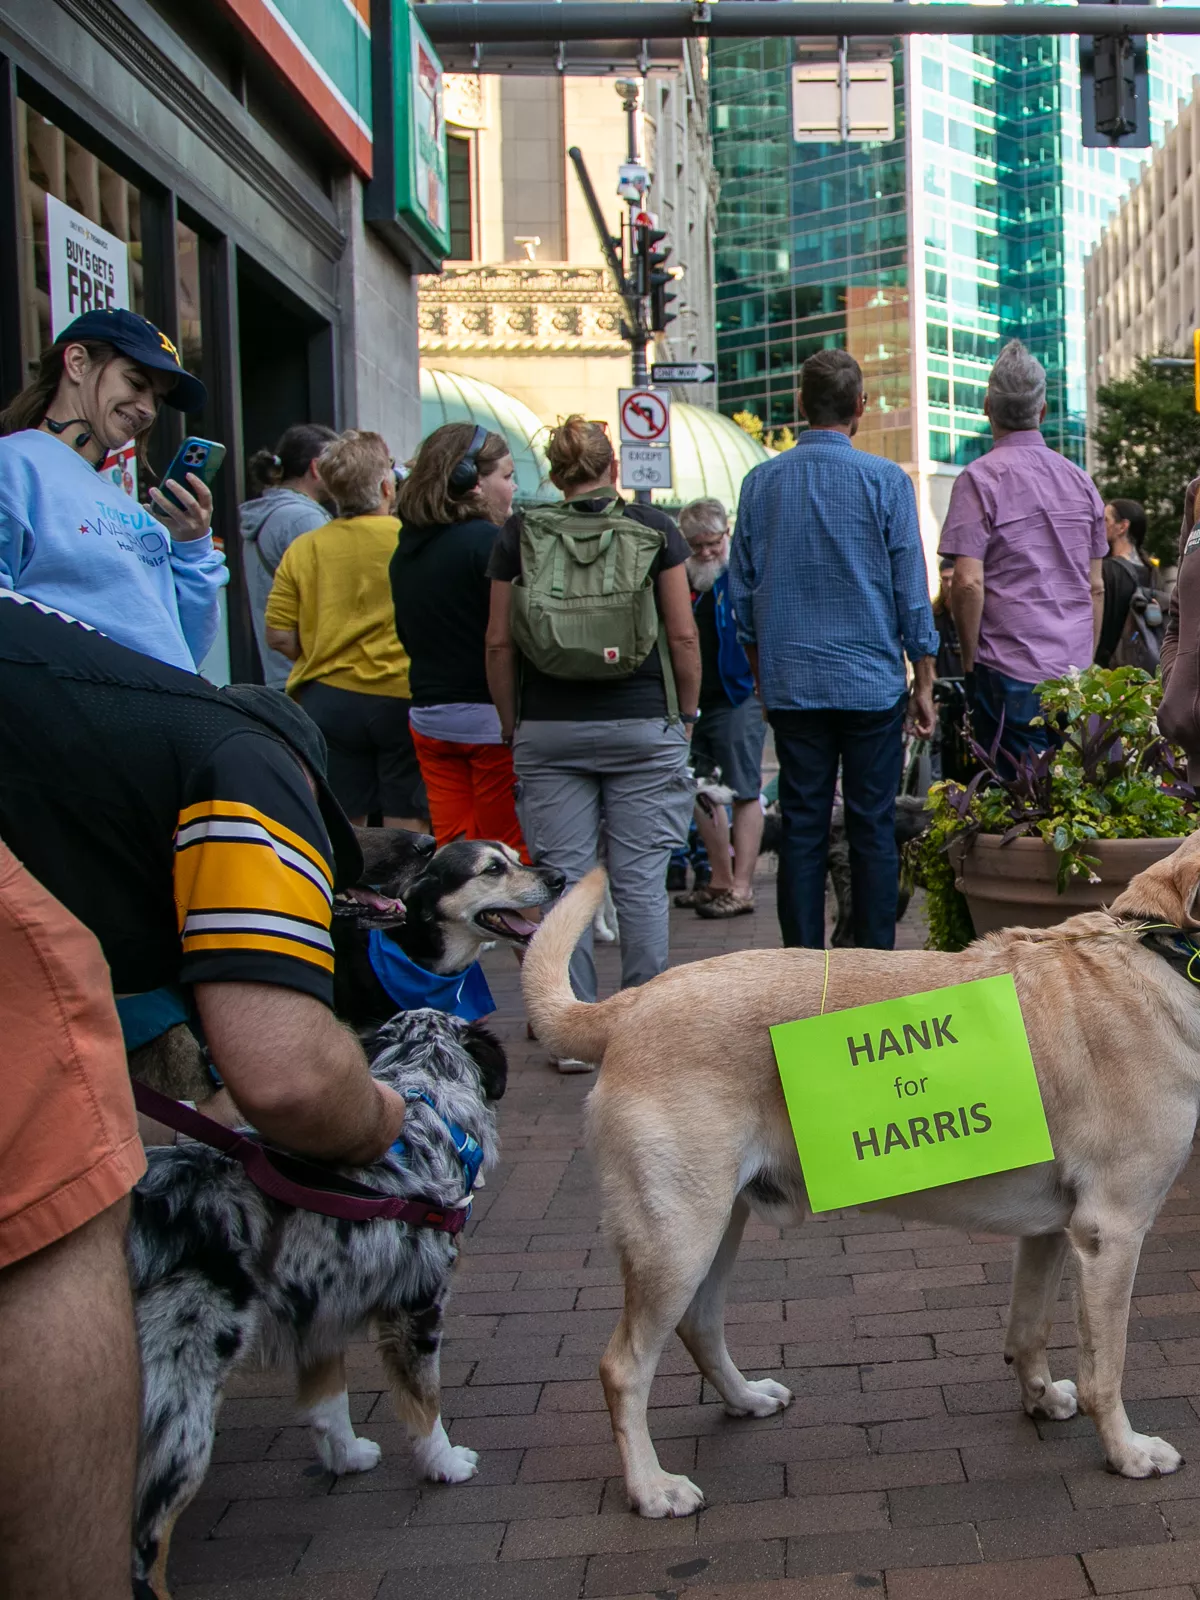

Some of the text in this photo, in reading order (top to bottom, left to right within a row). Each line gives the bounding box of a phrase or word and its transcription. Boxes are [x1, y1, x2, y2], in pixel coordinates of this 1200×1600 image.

[65, 237, 115, 285] BUY 5 GET 5
[628, 451, 663, 461] EXCEPT
[846, 1014, 959, 1066] HANK
[893, 1076, 929, 1099] for
[852, 1102, 992, 1161] HARRIS
